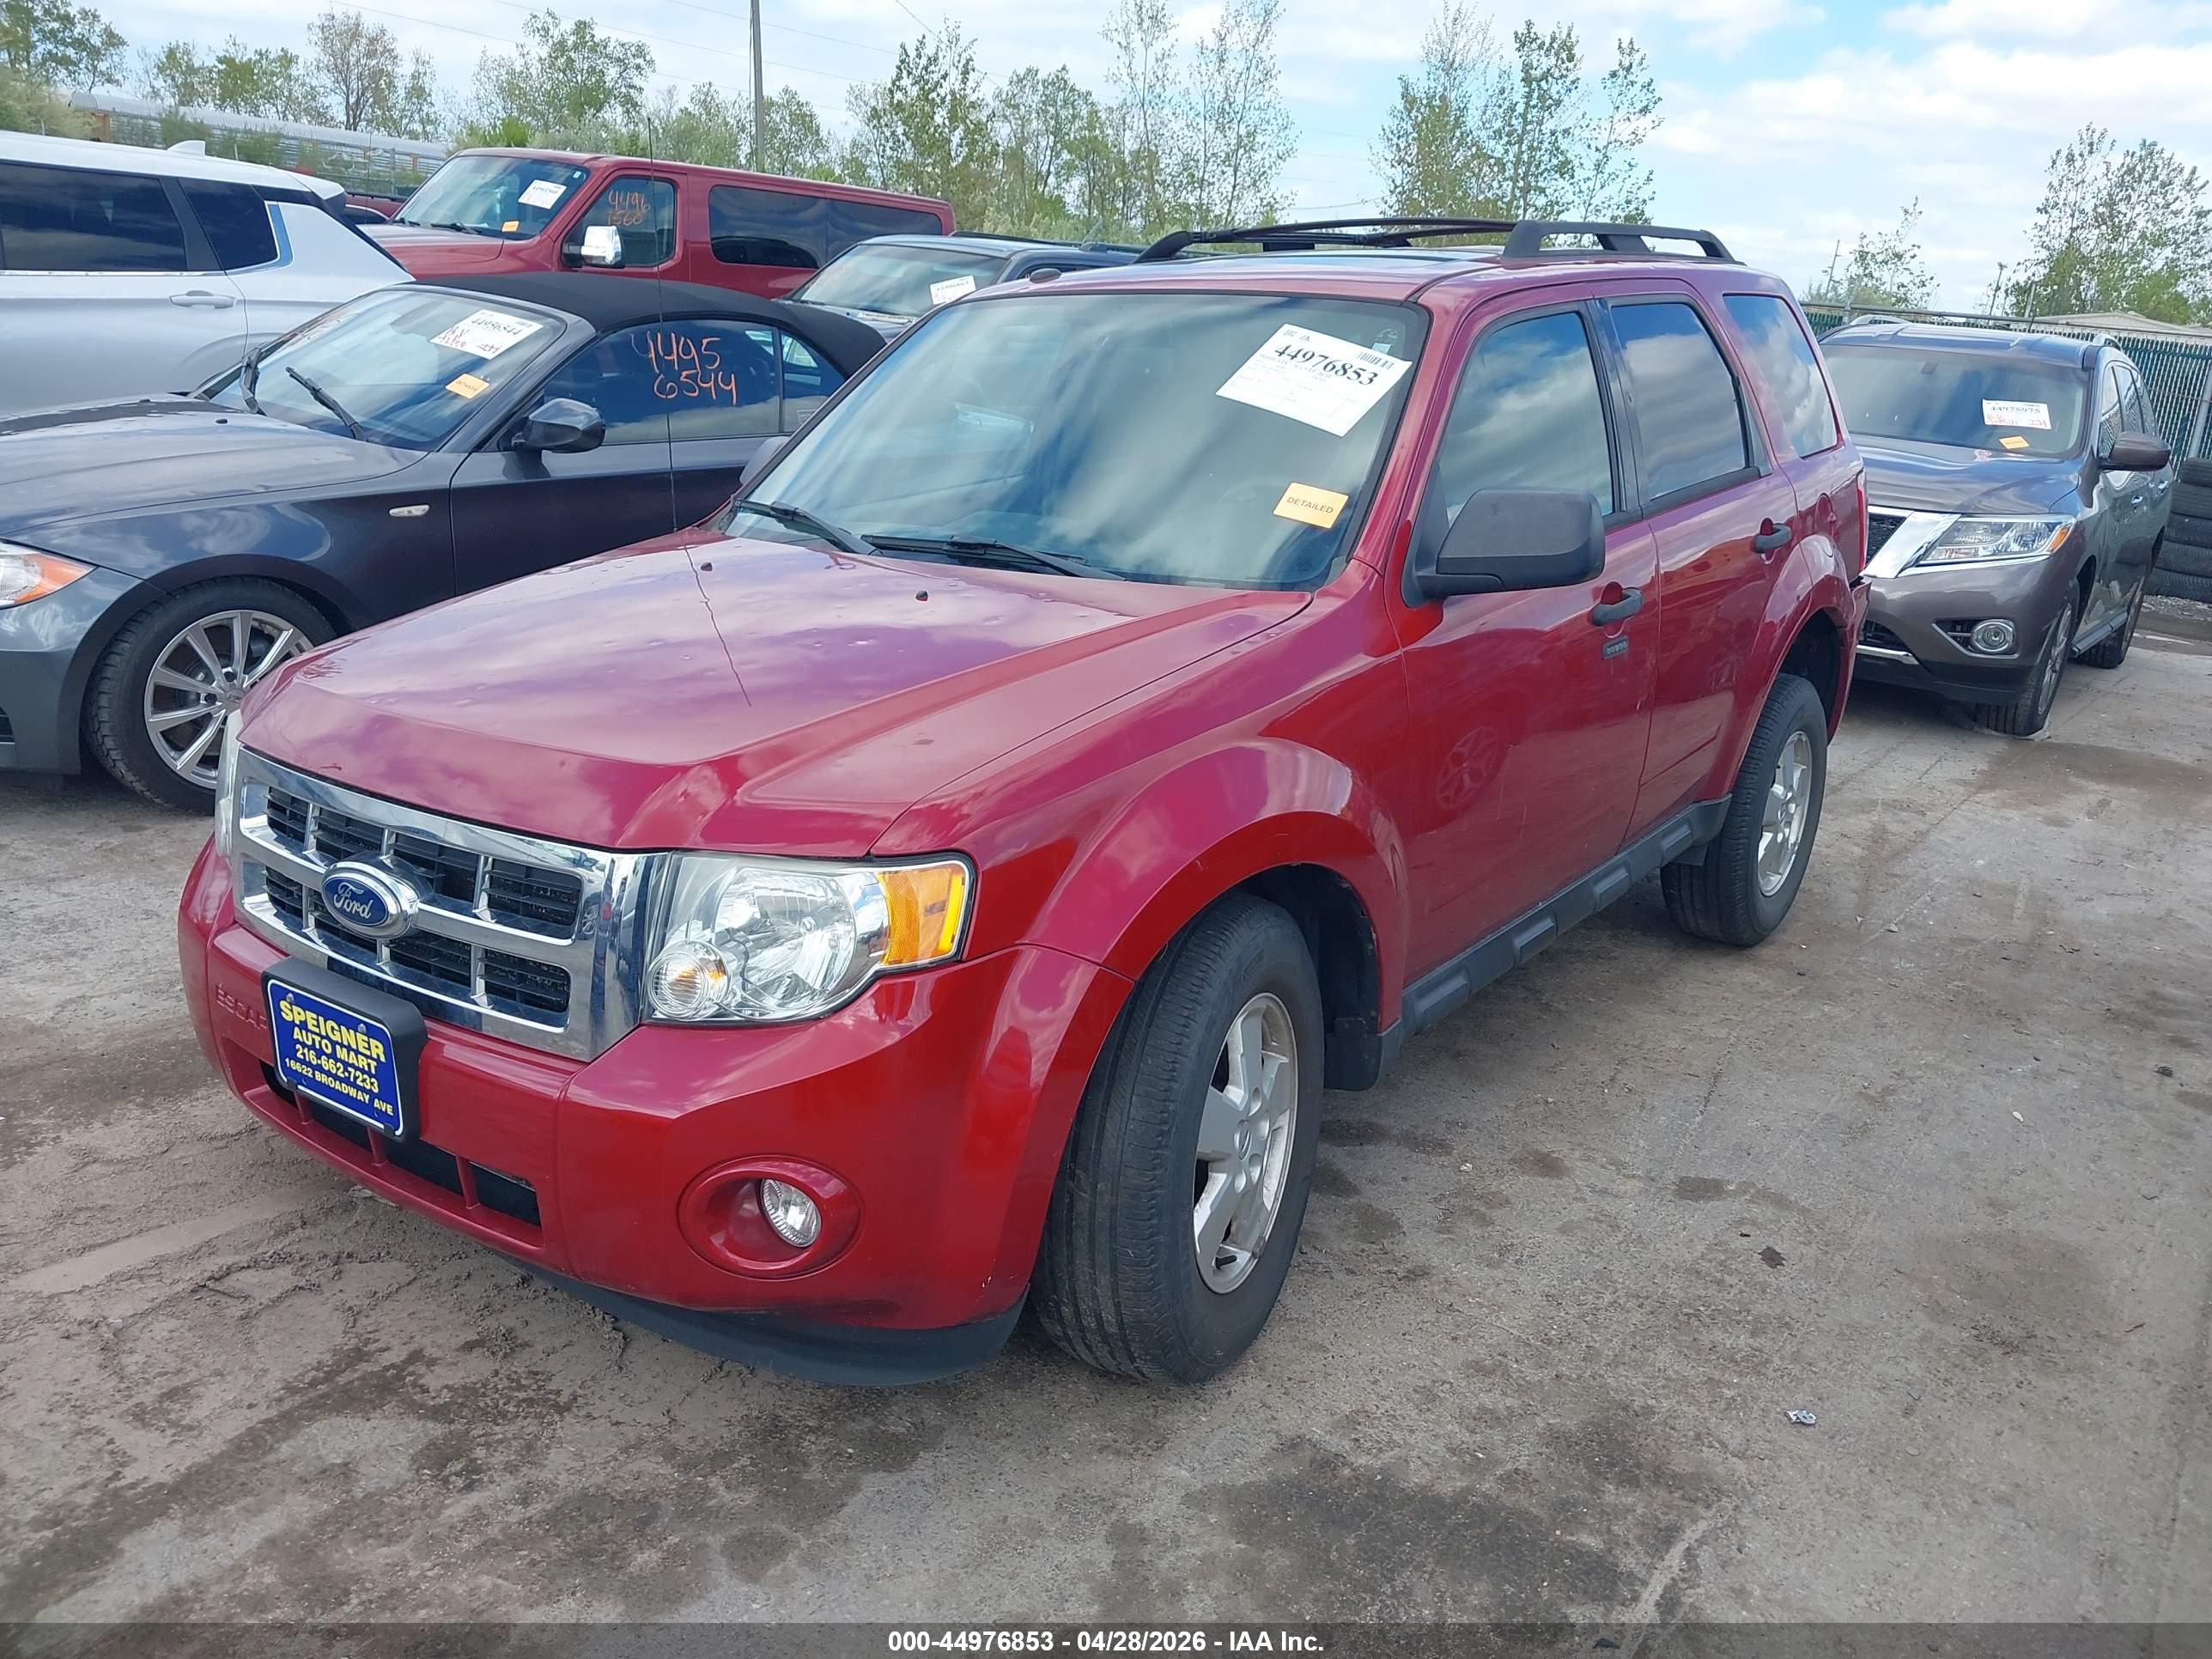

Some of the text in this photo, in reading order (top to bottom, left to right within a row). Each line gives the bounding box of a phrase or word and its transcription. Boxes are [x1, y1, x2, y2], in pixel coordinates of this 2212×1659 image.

[607, 210, 643, 227] 1560
[608, 188, 651, 213] 4496
[631, 330, 721, 374] 4495
[1274, 344, 1378, 386] 44976853
[653, 369, 738, 406] 6544
[1286, 495, 1334, 514] DETAILED
[333, 882, 374, 919] Ford
[279, 1000, 386, 1063] SPEIGNER
[293, 1027, 377, 1075] AUTO MART
[285, 1057, 394, 1116] 16622 BROADWAY AVE
[295, 1043, 380, 1094] 216-662-7233
